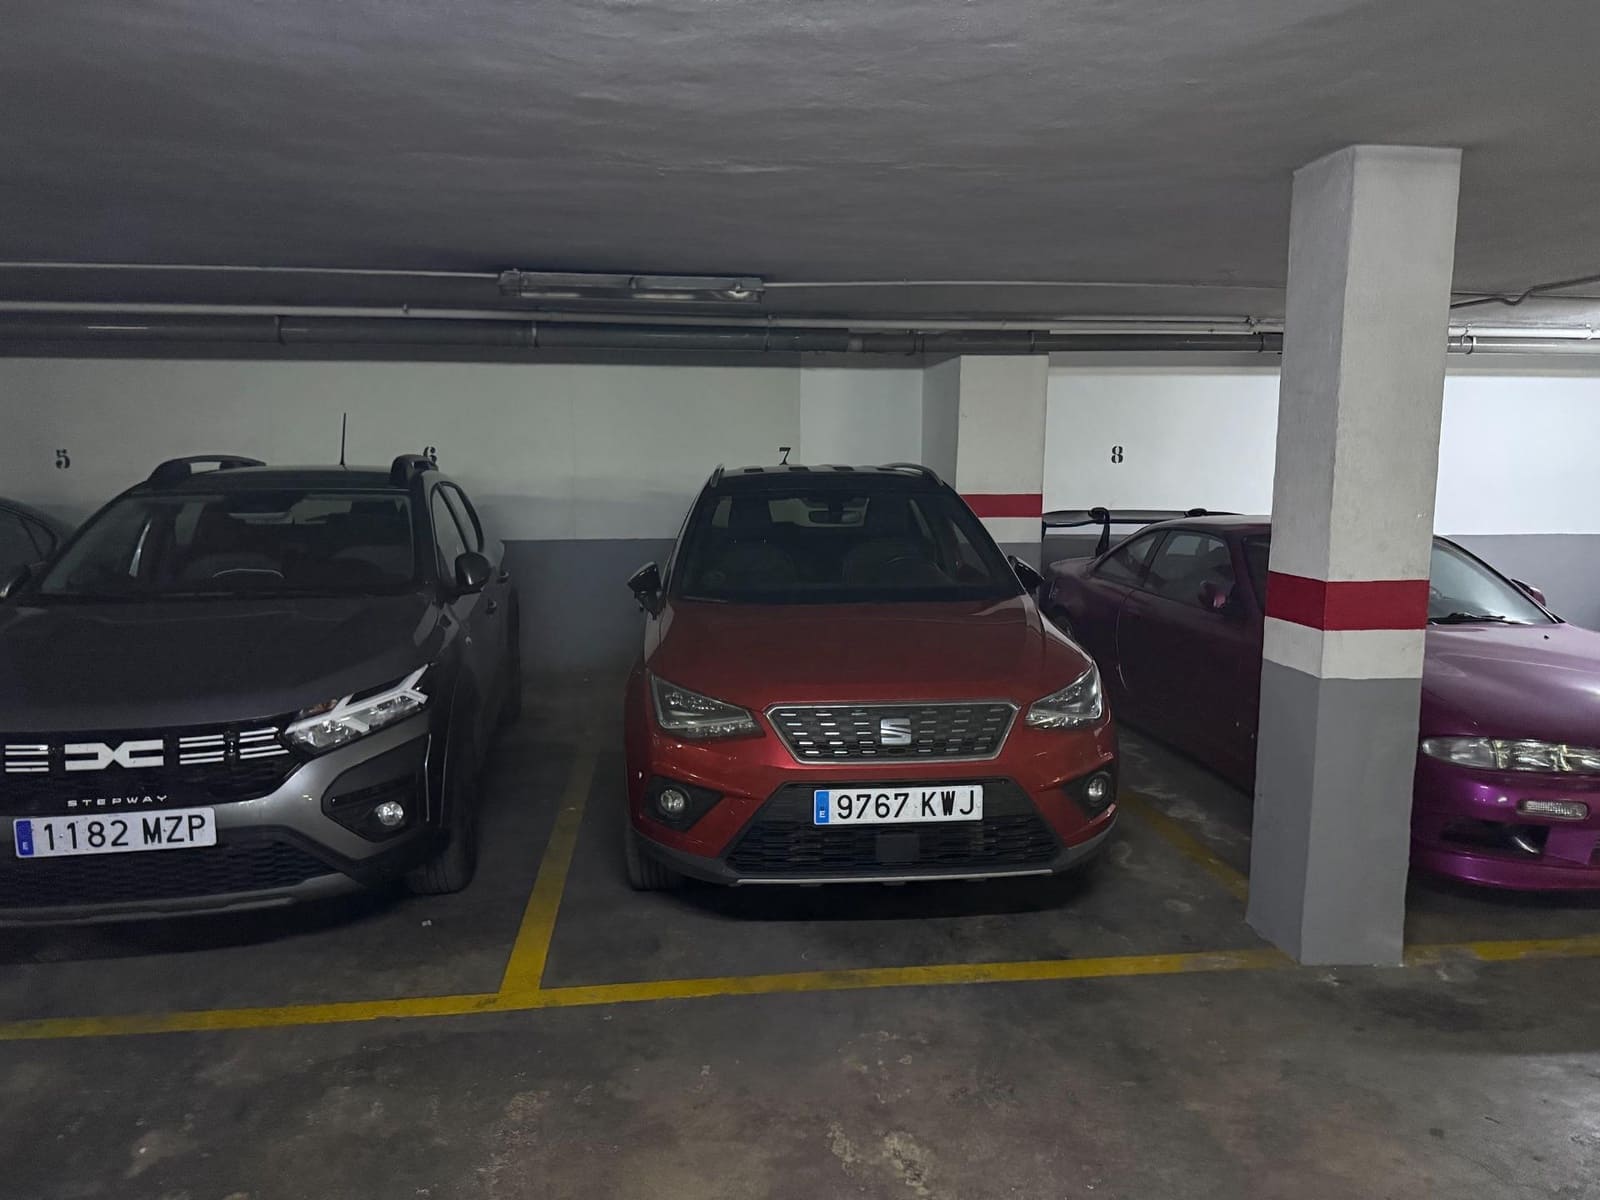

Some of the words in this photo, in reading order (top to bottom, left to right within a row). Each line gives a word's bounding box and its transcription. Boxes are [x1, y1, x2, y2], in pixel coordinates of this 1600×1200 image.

[55, 448, 71, 470] 5
[423, 445, 437, 464] 6
[779, 446, 791, 466] 7
[1111, 445, 1124, 464] 8
[67, 794, 168, 808] STEPWAY
[837, 792, 910, 820] 9767
[920, 789, 975, 817] KWJ
[43, 819, 129, 850] 1182
[142, 815, 206, 845] MZP
